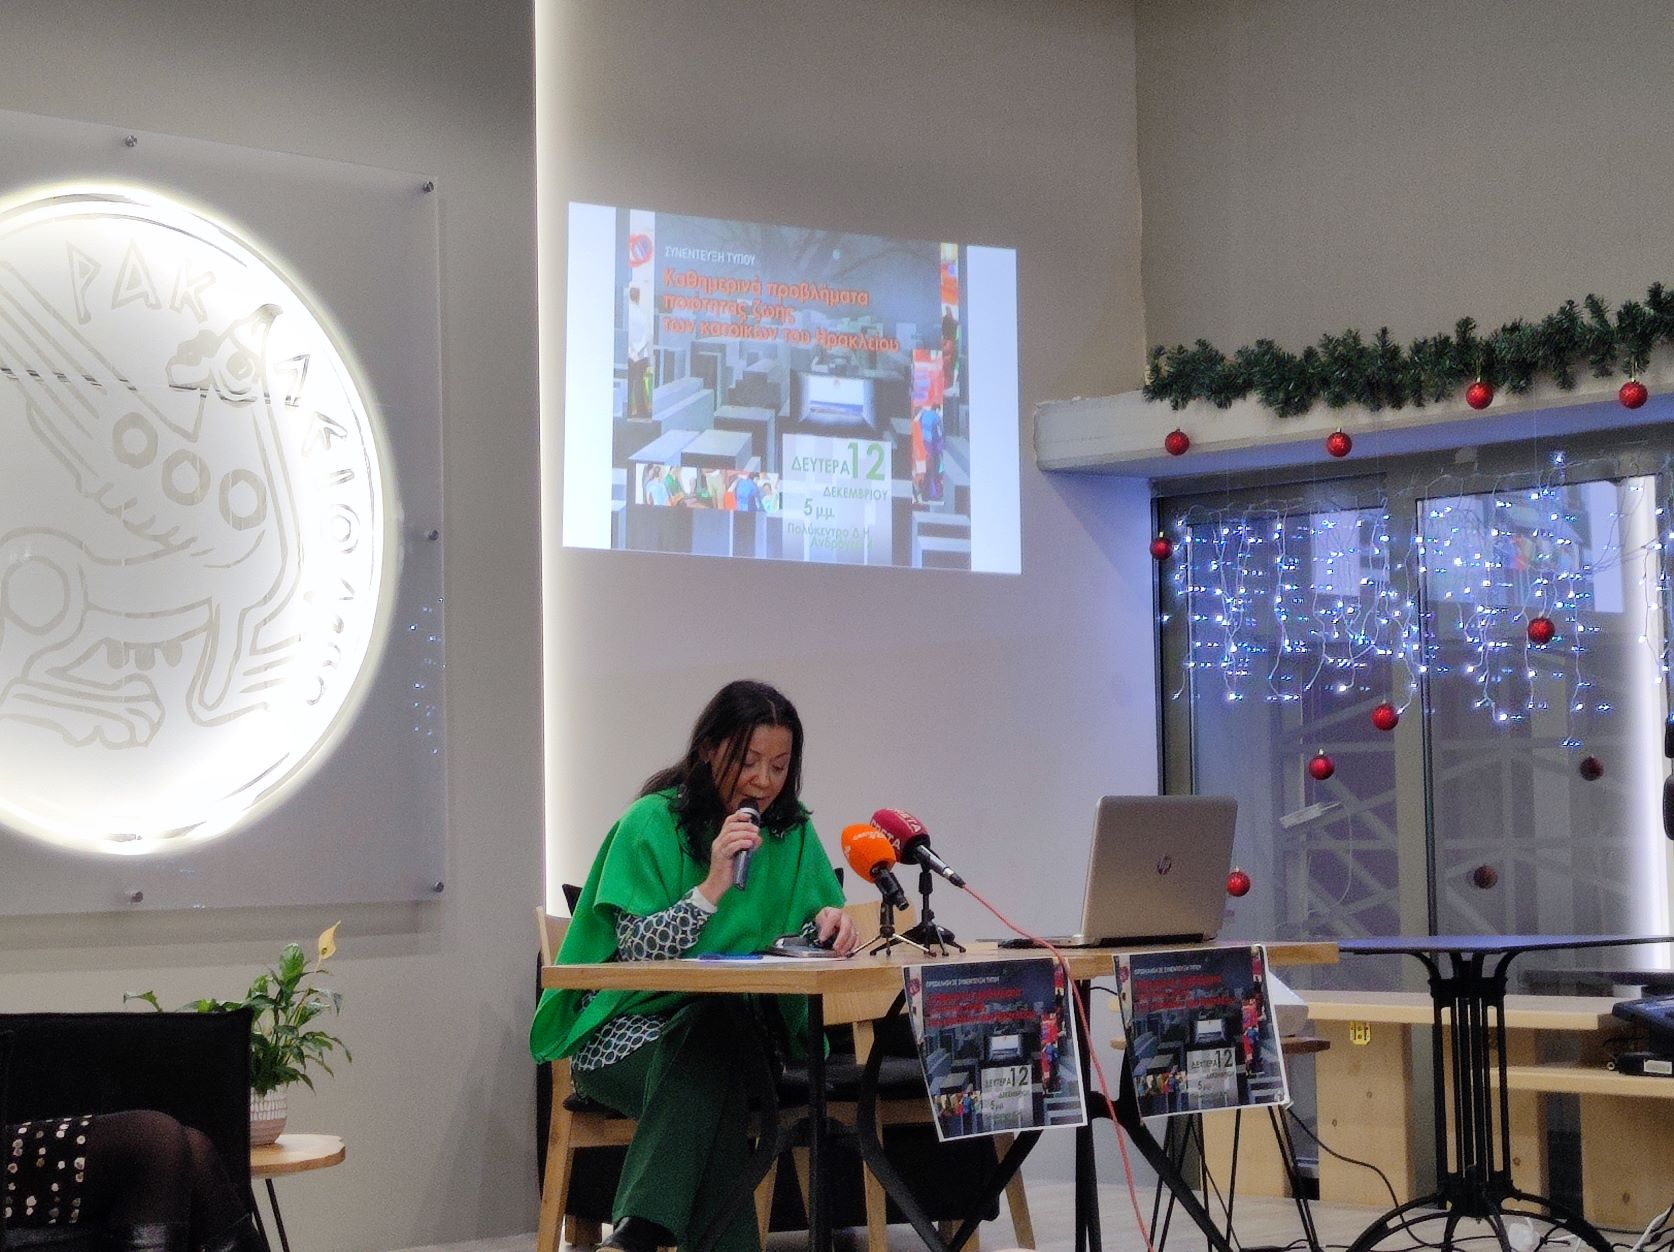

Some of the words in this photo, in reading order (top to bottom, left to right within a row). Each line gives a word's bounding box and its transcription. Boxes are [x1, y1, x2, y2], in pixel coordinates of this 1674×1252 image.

[664, 246, 725, 264] ΣΥΝΕΝΤΕΥΞΗ
[726, 250, 756, 265] ΤΥΠΟΥ
[663, 268, 761, 295] Καθημερινά
[767, 281, 870, 308] προβλήματα
[663, 291, 747, 318] ποιότητας
[752, 300, 797, 324] ζωής
[663, 317, 696, 334] των
[700, 320, 778, 342] κατοίκων
[783, 328, 811, 343] του
[815, 329, 900, 352] Ηρακλείου
[791, 456, 850, 475] ΔΕΥΤΕΡΑ
[847, 441, 886, 481] 12
[822, 486, 889, 501] ΔΕΚΕΜΒΡΙΟΥ
[803, 497, 813, 517] 5
[815, 505, 836, 520] μ.μ.
[787, 521, 849, 540] Πολύκεντρο
[1215, 1050, 1233, 1068] 12
[1010, 1066, 1029, 1087] 12
